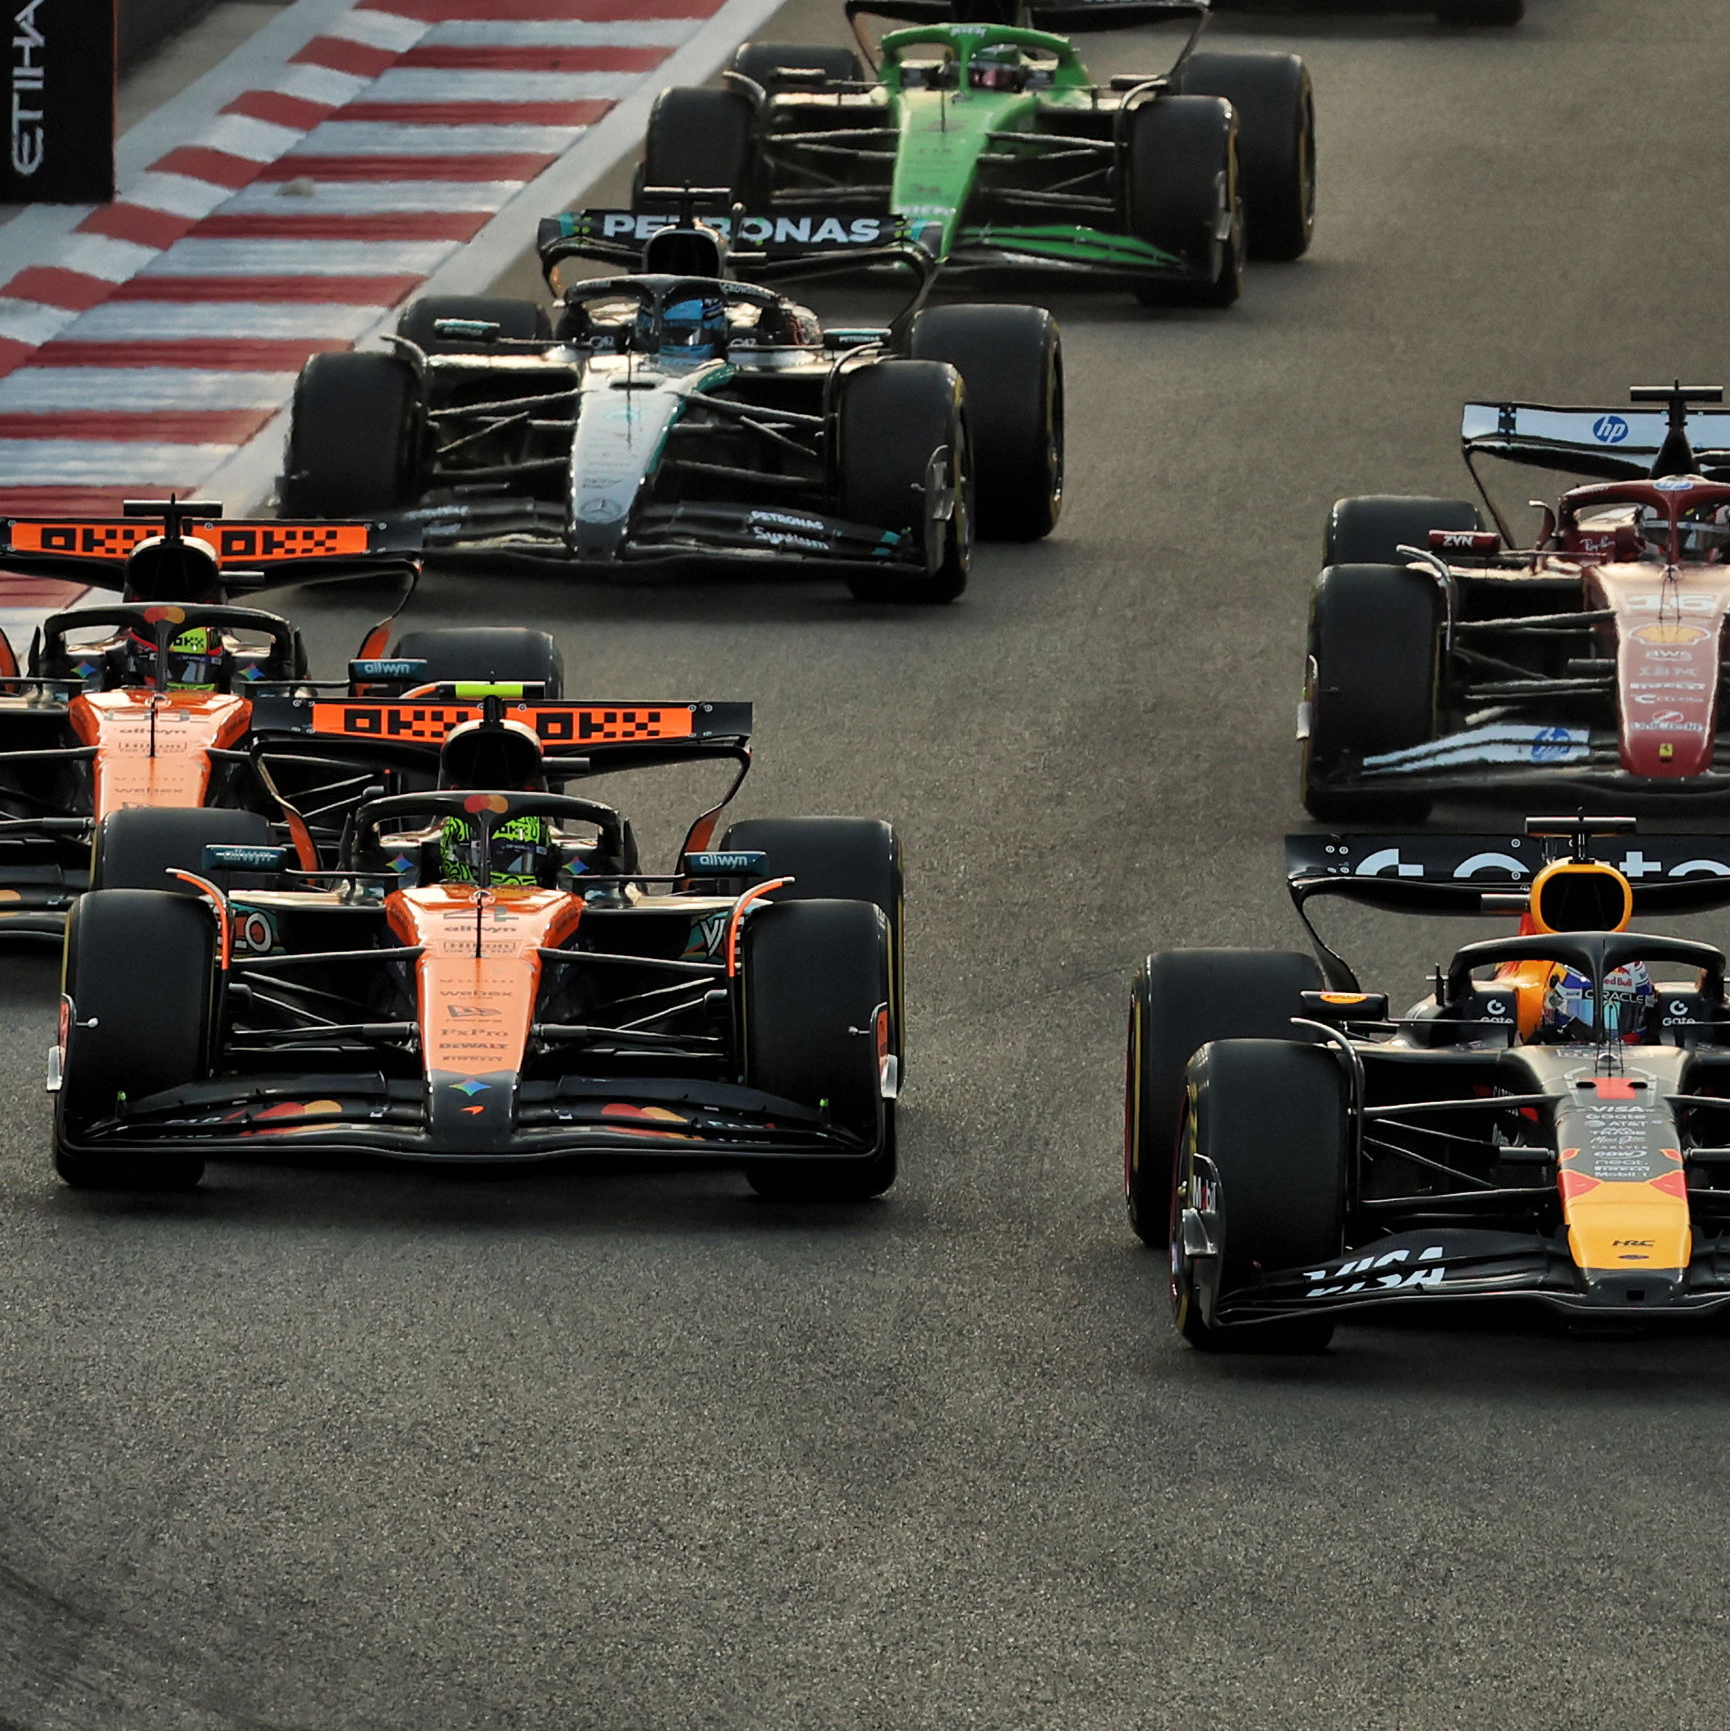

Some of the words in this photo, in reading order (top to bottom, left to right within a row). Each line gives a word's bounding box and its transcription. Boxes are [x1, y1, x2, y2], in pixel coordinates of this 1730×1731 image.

[1598, 416, 1627, 443] hp
[752, 510, 824, 530] PETRONAS
[221, 530, 338, 556] OKX
[1443, 535, 1475, 549] ZYN
[365, 661, 410, 676] allwyn
[536, 712, 661, 741] OKX
[700, 854, 749, 870] allwyn
[1603, 977, 1616, 986] ed
[1617, 978, 1633, 987] Bull
[1303, 1246, 1446, 1298] VISA
